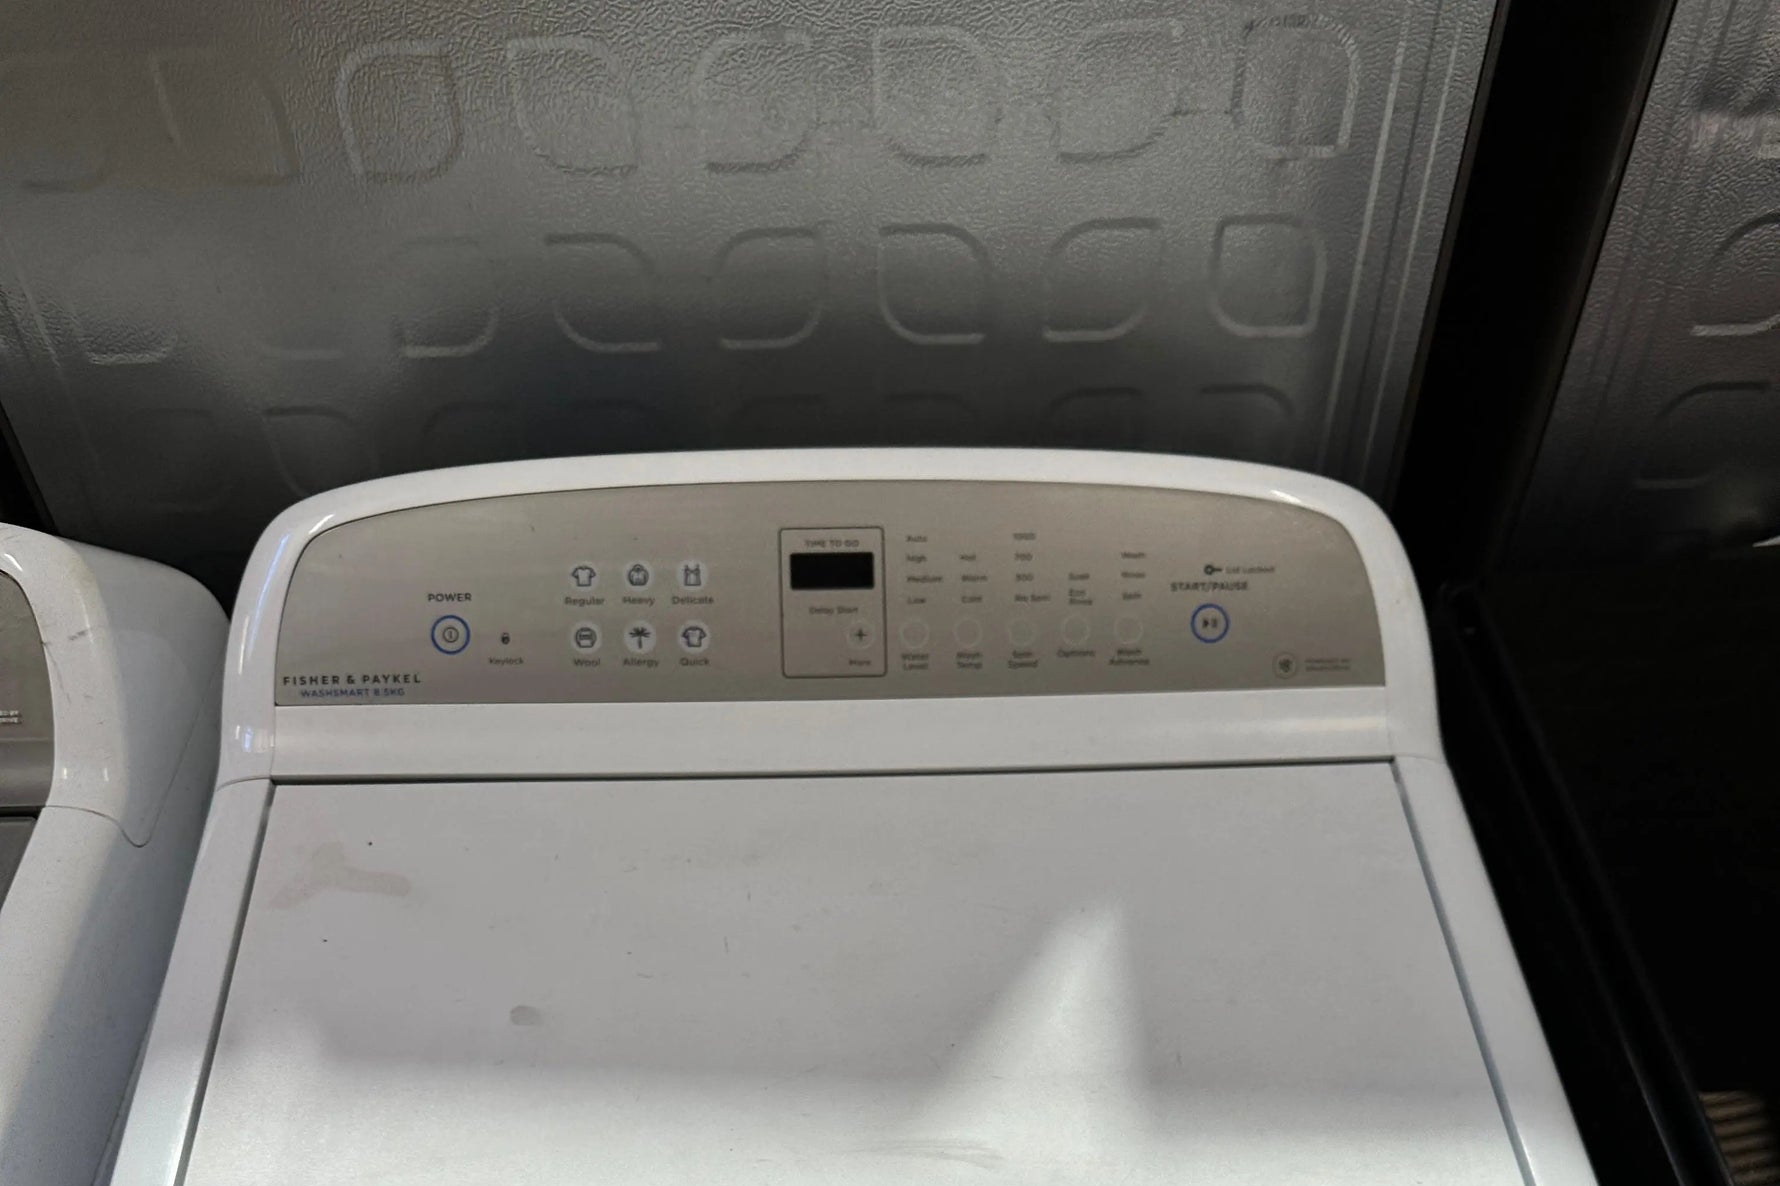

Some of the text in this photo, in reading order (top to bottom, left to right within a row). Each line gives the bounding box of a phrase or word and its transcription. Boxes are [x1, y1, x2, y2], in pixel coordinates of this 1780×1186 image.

[804, 539, 860, 548] TIME TO GO
[1170, 581, 1248, 592] START/PAUSE
[427, 592, 472, 602] POWER
[564, 596, 605, 607] Regular
[622, 596, 655, 606] Heavy
[671, 596, 714, 605] Delicate
[1057, 649, 1095, 658] Options
[489, 657, 524, 666] Keylock
[573, 658, 601, 667] Wool
[623, 658, 659, 668] Allergy
[680, 657, 710, 667] Quick
[283, 672, 422, 686] FISHER & PAYKEL
[300, 688, 370, 698] WASHSMART
